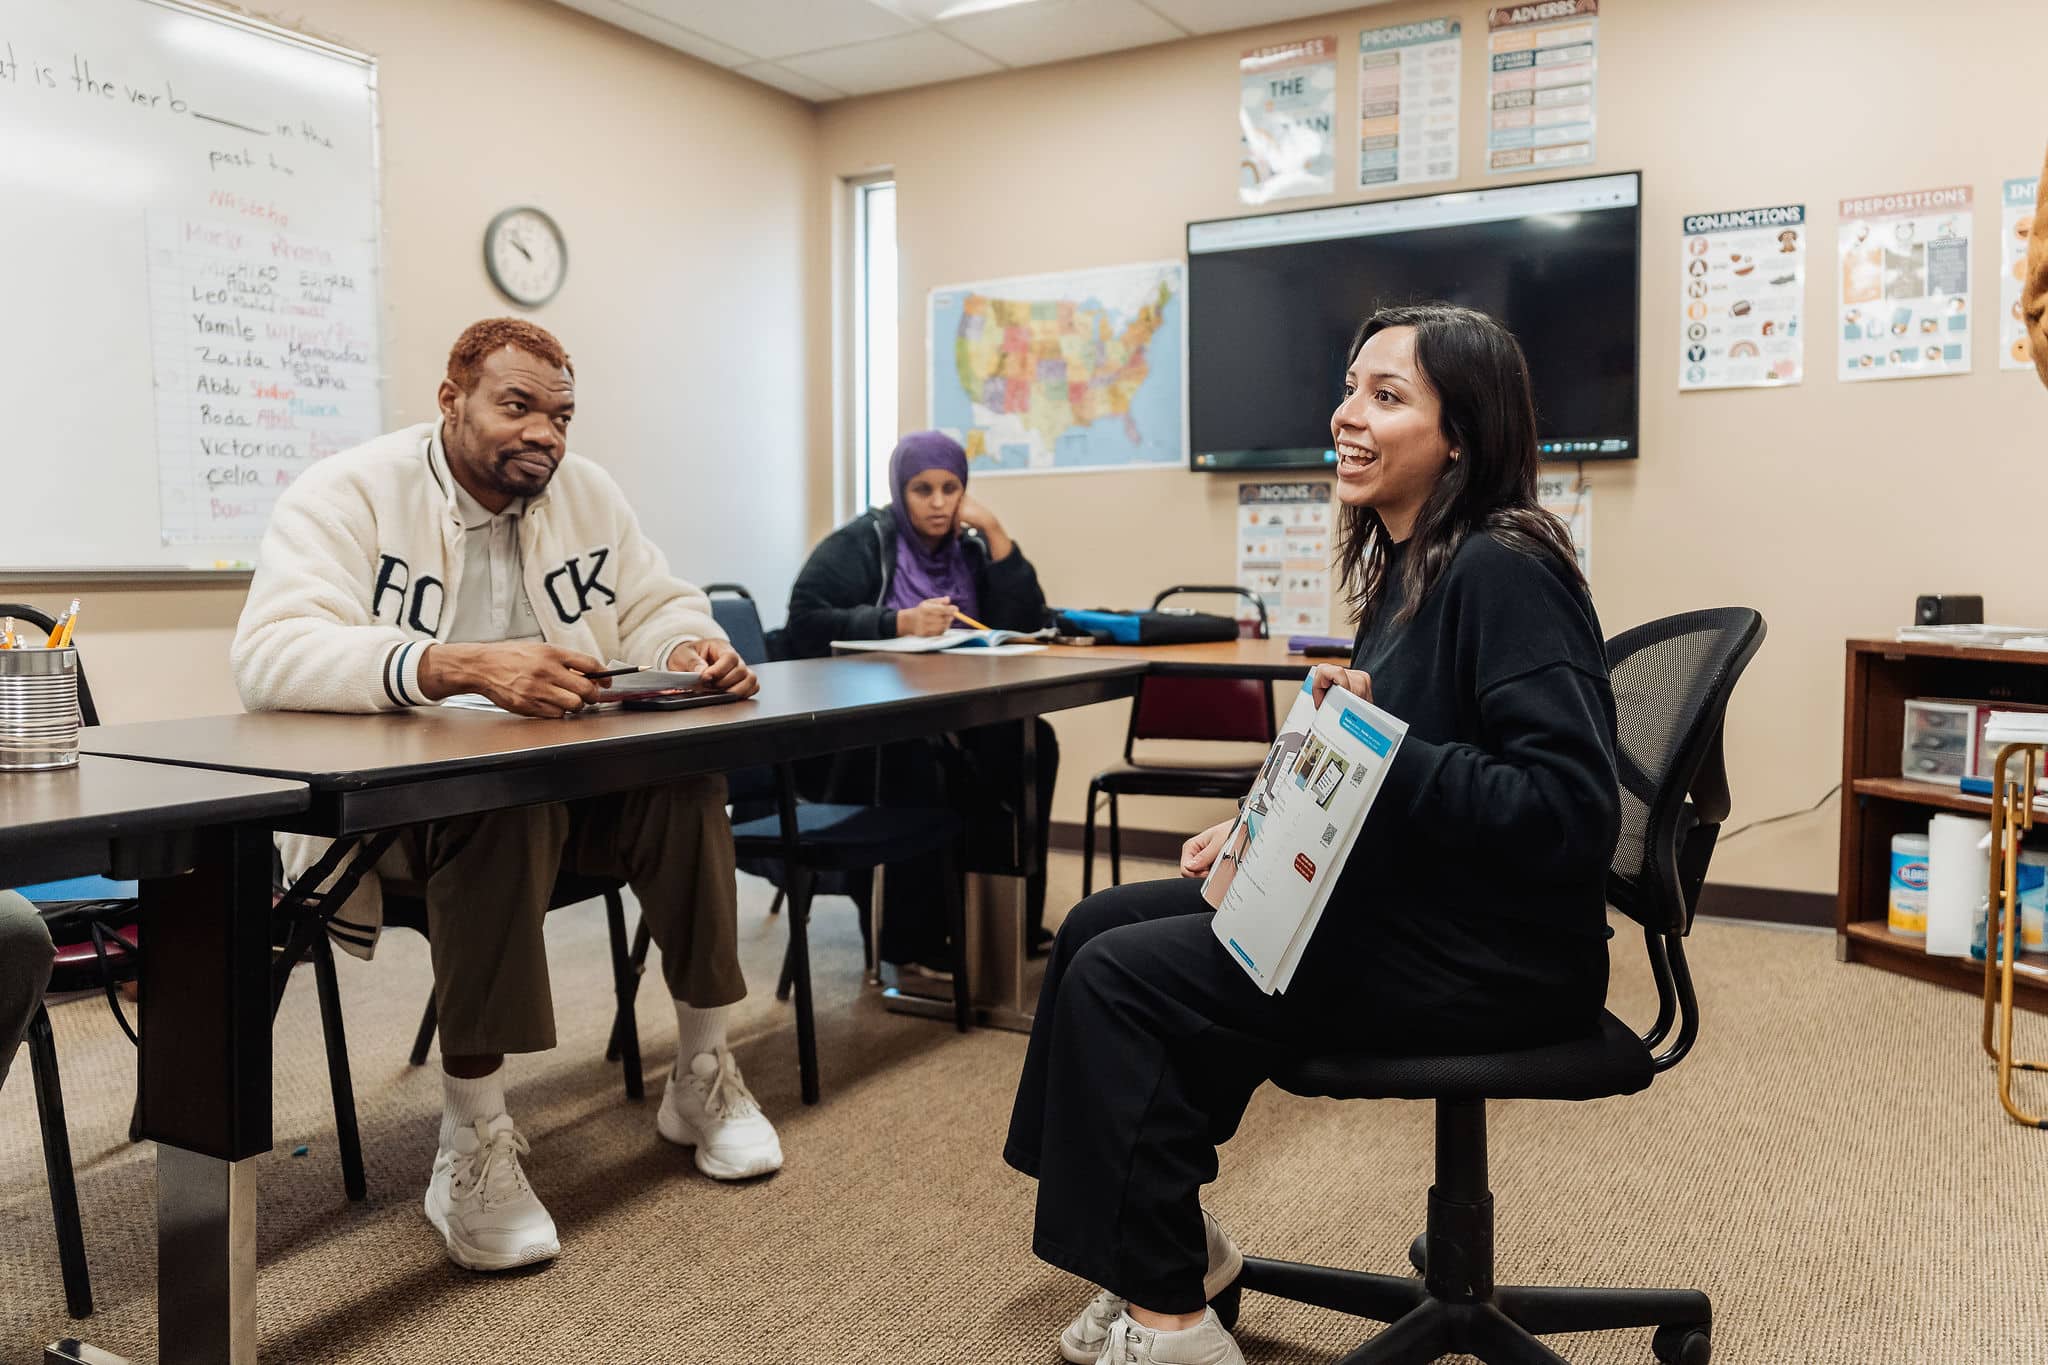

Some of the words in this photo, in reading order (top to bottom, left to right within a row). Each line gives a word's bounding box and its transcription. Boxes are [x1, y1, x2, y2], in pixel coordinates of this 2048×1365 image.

[1510, 0, 1577, 24] ADVERBS
[1362, 19, 1445, 46] PRONOUNS
[35, 65, 57, 88] is
[71, 53, 116, 100] the
[124, 80, 188, 114] verb
[1269, 76, 1305, 97] THE
[1843, 188, 1967, 215] PREPOSITIONS
[1685, 206, 1800, 232] CONJUNCTIONS
[199, 437, 302, 460] Victorina
[1258, 485, 1310, 499] NOUNS
